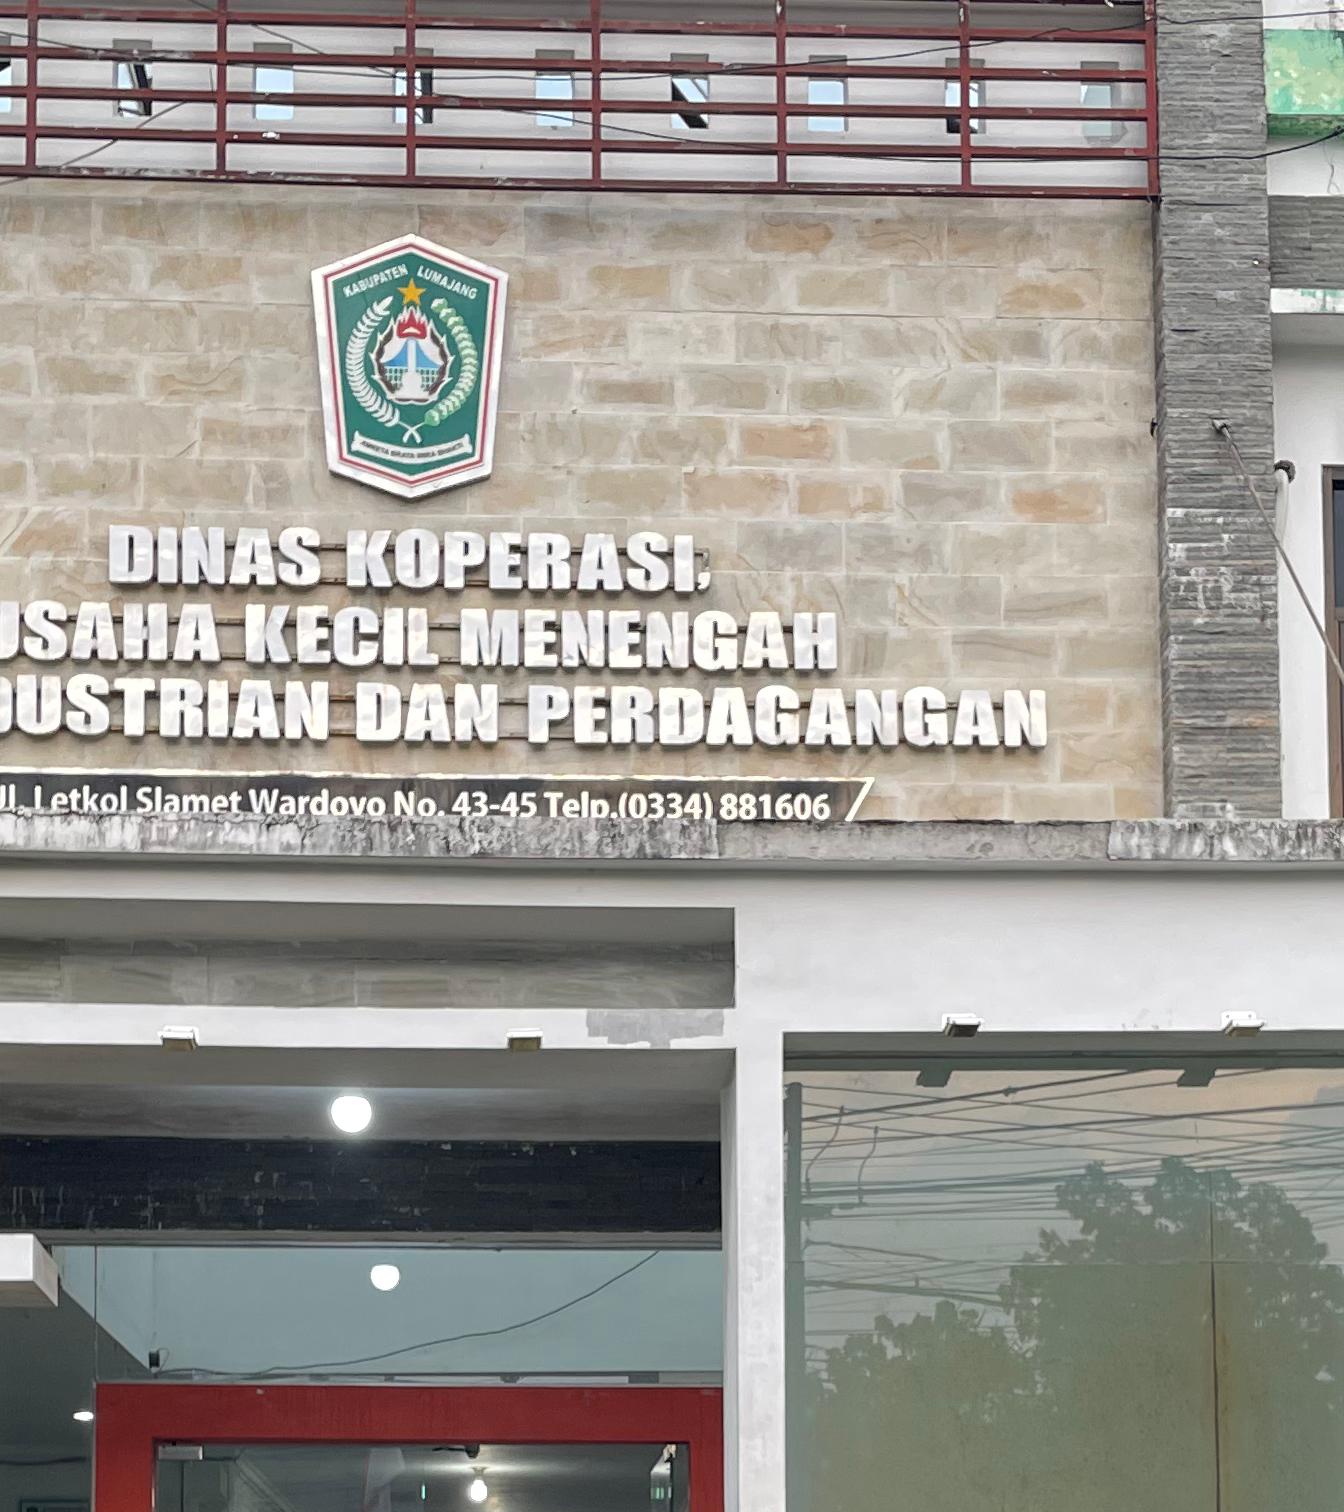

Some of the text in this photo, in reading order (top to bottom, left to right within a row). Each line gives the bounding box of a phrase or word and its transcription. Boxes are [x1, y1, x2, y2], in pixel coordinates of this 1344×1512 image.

[342, 264, 478, 299] KABUPATEN LUMAJANG
[108, 524, 711, 592] DINAS KOPERASI,
[244, 603, 439, 667] KECIL
[460, 609, 838, 671] MENENGAH
[356, 683, 498, 743] DAN
[528, 685, 1047, 748] PERDAGANGAN
[136, 784, 241, 813] Slamet
[394, 790, 445, 816] No.
[454, 791, 538, 817] 43-45
[719, 793, 831, 819] 881606
